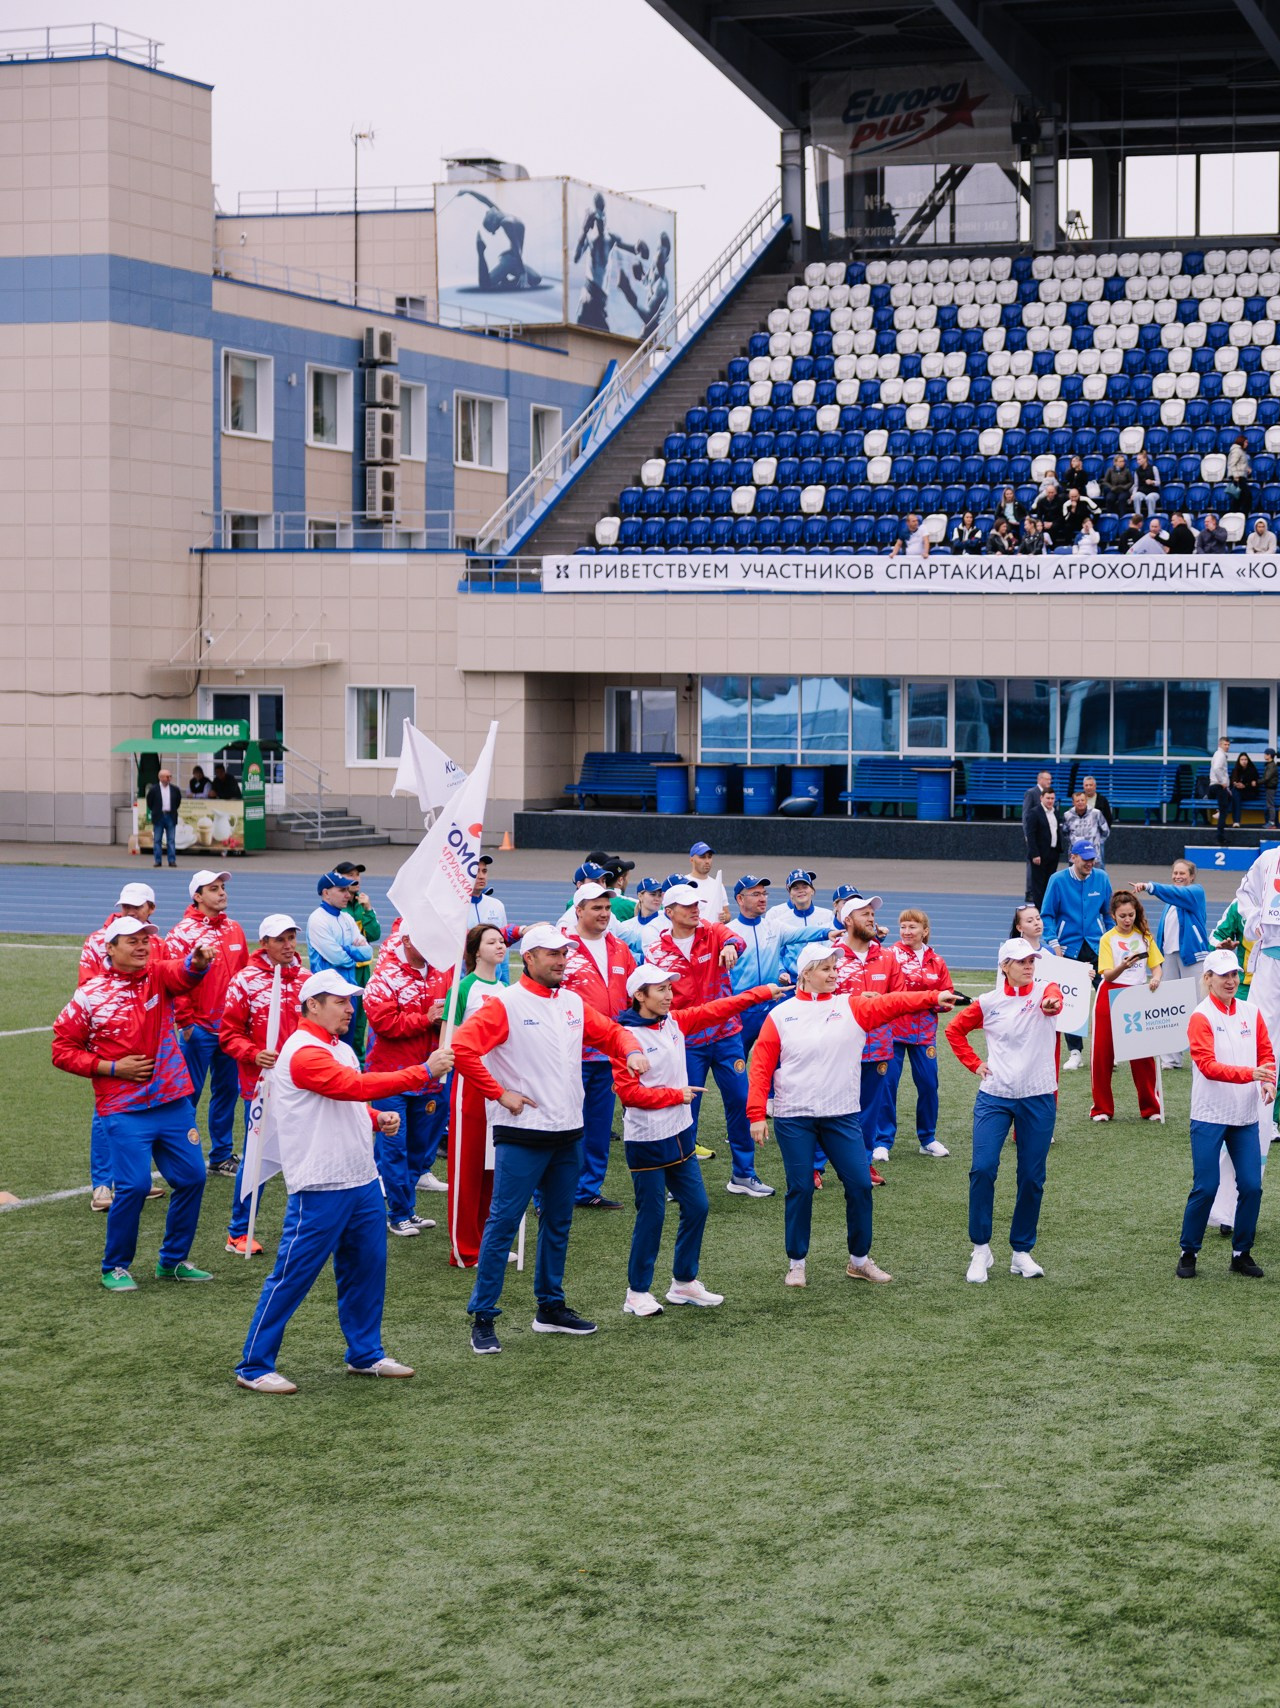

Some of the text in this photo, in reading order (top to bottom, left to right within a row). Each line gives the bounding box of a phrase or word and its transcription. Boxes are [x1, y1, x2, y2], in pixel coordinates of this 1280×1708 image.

[579, 564, 729, 579] ПРИВЕТСТВУЕМ
[742, 563, 875, 580] УЧАСТНИКОВ
[885, 563, 1041, 582] СПАРТАКИАДЫ
[1053, 562, 1224, 581] АГРОХОЛДИНГА
[160, 723, 240, 736] МОРОЖЕНОЕ
[1215, 852, 1226, 866] 2
[1145, 1005, 1186, 1020] КОМОС
